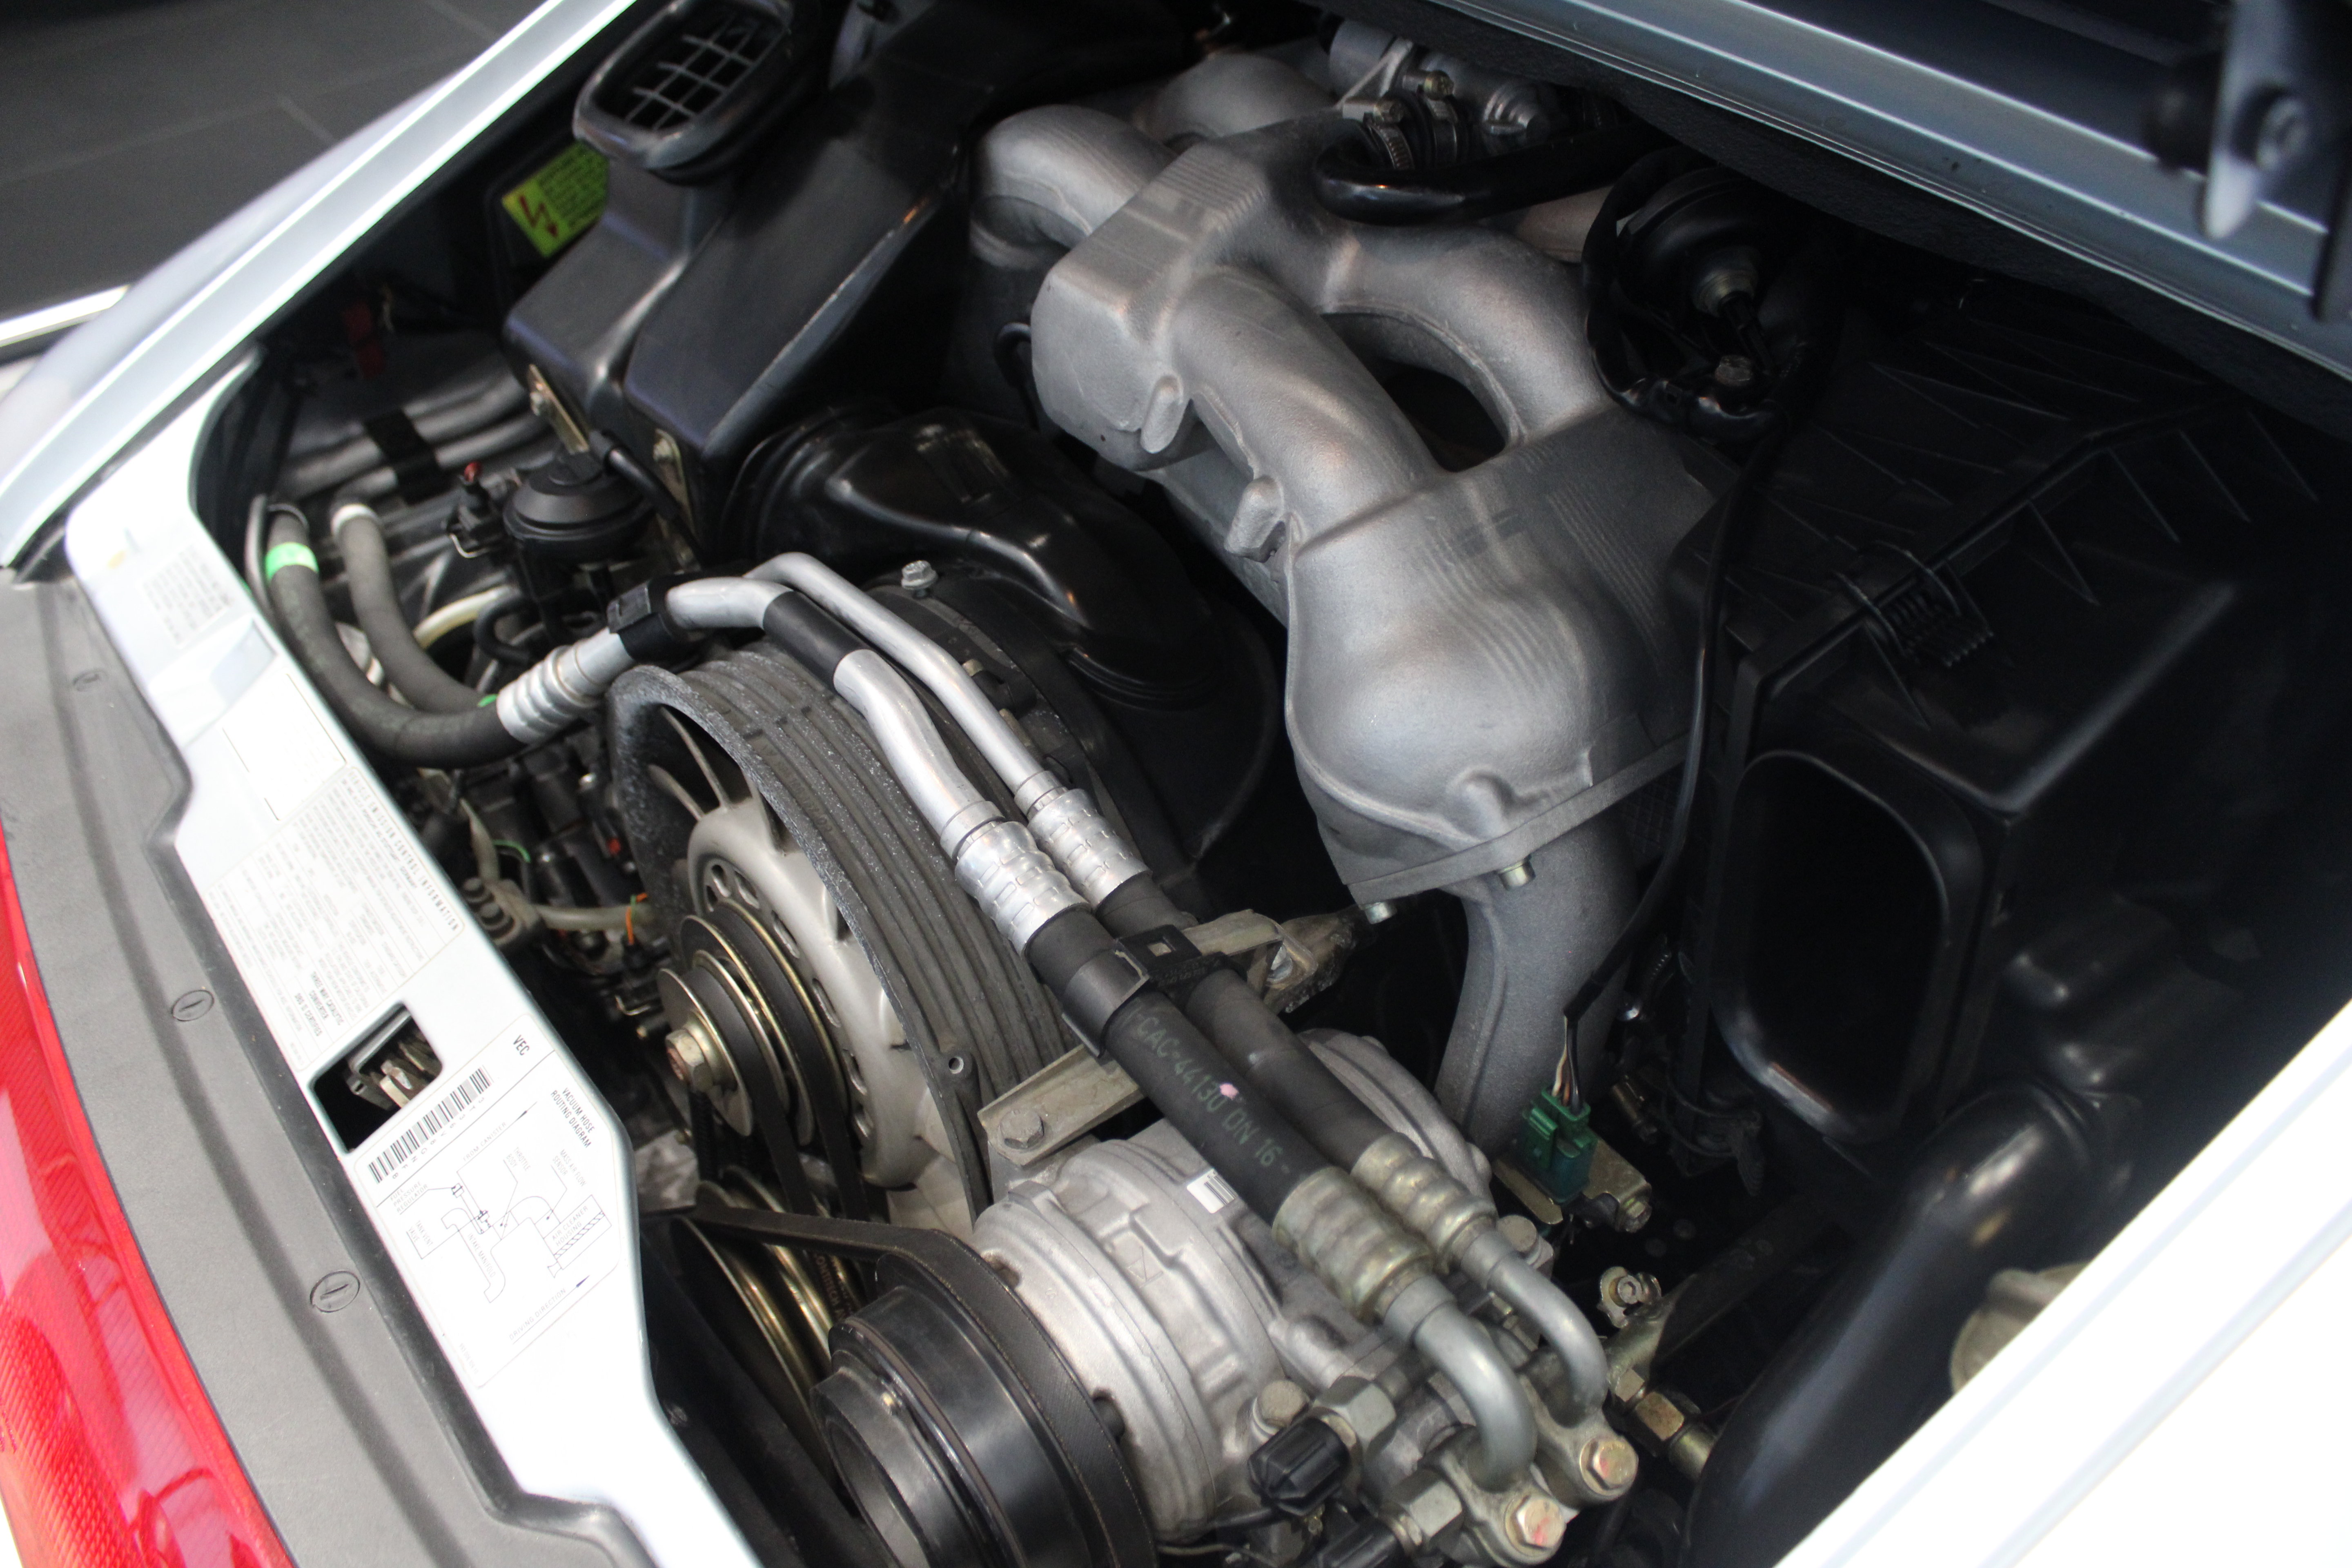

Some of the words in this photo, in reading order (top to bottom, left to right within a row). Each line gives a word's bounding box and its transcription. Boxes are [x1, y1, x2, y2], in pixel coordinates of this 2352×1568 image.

[393, 838, 422, 875] CONTROL
[417, 875, 460, 931] INFORMATION
[512, 1034, 530, 1056] VEC
[550, 1089, 572, 1118] ROUTING
[568, 1117, 591, 1148] DIAGRAM
[561, 1087, 583, 1116] VACUUM
[579, 1114, 595, 1133] HOSE
[463, 1145, 479, 1161] FROM
[479, 1122, 507, 1147] CANISTER
[1222, 1107, 1261, 1145] DN
[1255, 1137, 1283, 1167] 16
[506, 1153, 518, 1167] BODY
[512, 1146, 531, 1171] THROTTLE
[552, 1155, 568, 1176] SENSOR
[559, 1149, 571, 1164] MASS
[568, 1163, 577, 1173] AIR
[574, 1171, 587, 1187] FLOW
[389, 1188, 403, 1201] FUEL
[392, 1180, 421, 1207] PRESSURE
[396, 1183, 428, 1213] REGULATOR
[408, 1226, 420, 1243] VALVE
[414, 1220, 425, 1234] TANK
[422, 1232, 433, 1246] VENT
[551, 1229, 562, 1241] AIR
[559, 1205, 589, 1231] CLEANER
[555, 1221, 584, 1247] HOUSING
[467, 1233, 481, 1251] INTAKE
[477, 1250, 496, 1278] MANIFOLD
[508, 1316, 535, 1340] DRIVING
[534, 1288, 568, 1317] DIRECTION
